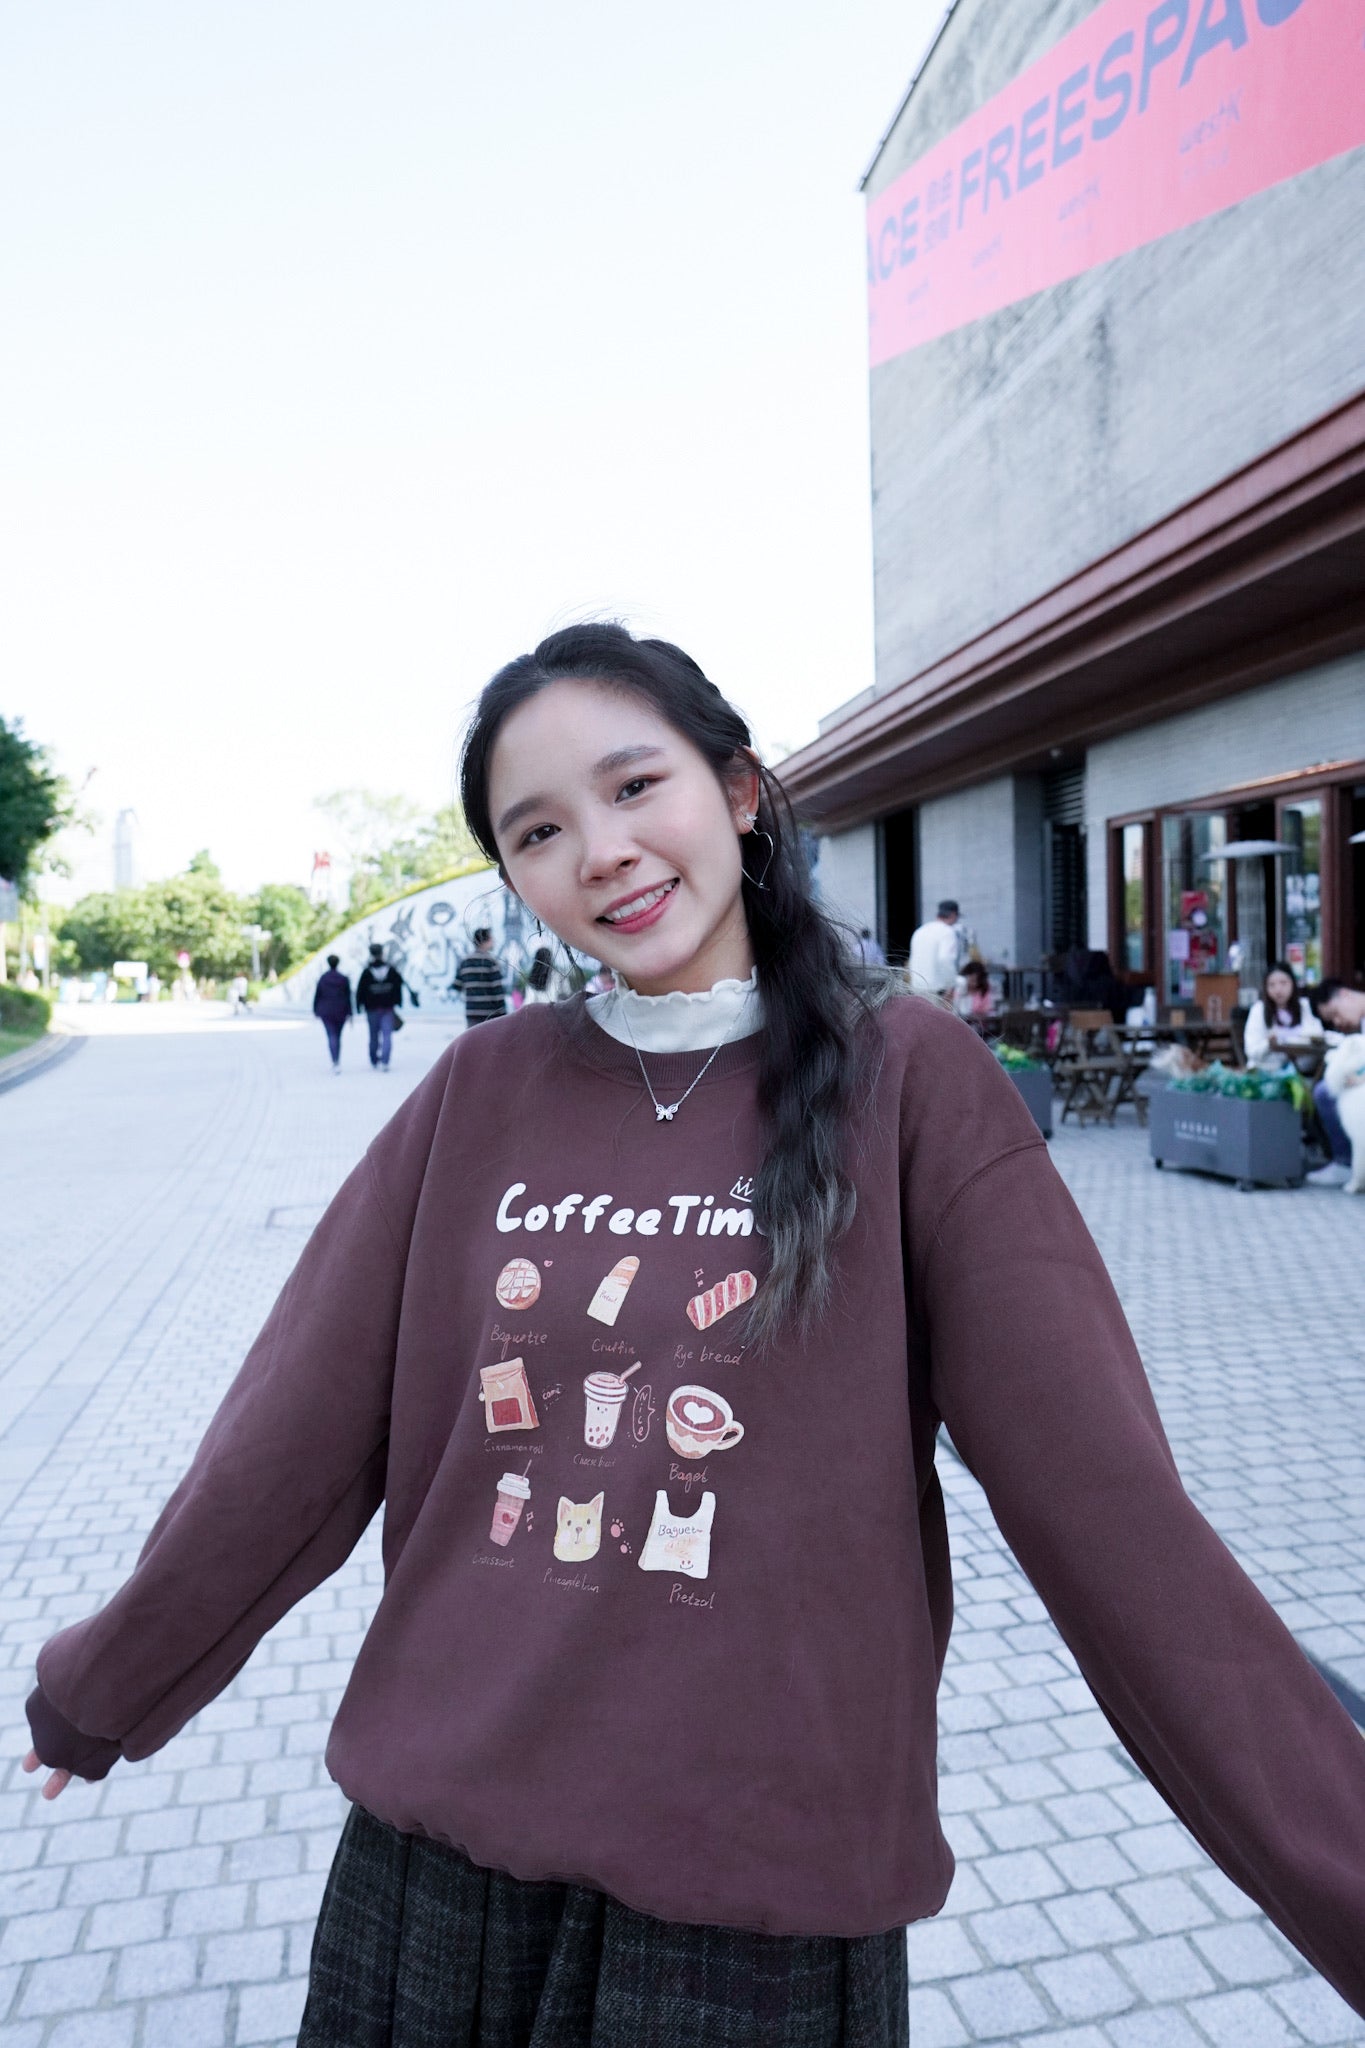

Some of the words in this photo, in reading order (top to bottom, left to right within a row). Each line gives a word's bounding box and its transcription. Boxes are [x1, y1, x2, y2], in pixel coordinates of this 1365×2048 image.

[956, 0, 1306, 231] FREESPA
[668, 1195, 764, 1237] Tim
[673, 1344, 695, 1369] Rye
[700, 1345, 743, 1365] bread
